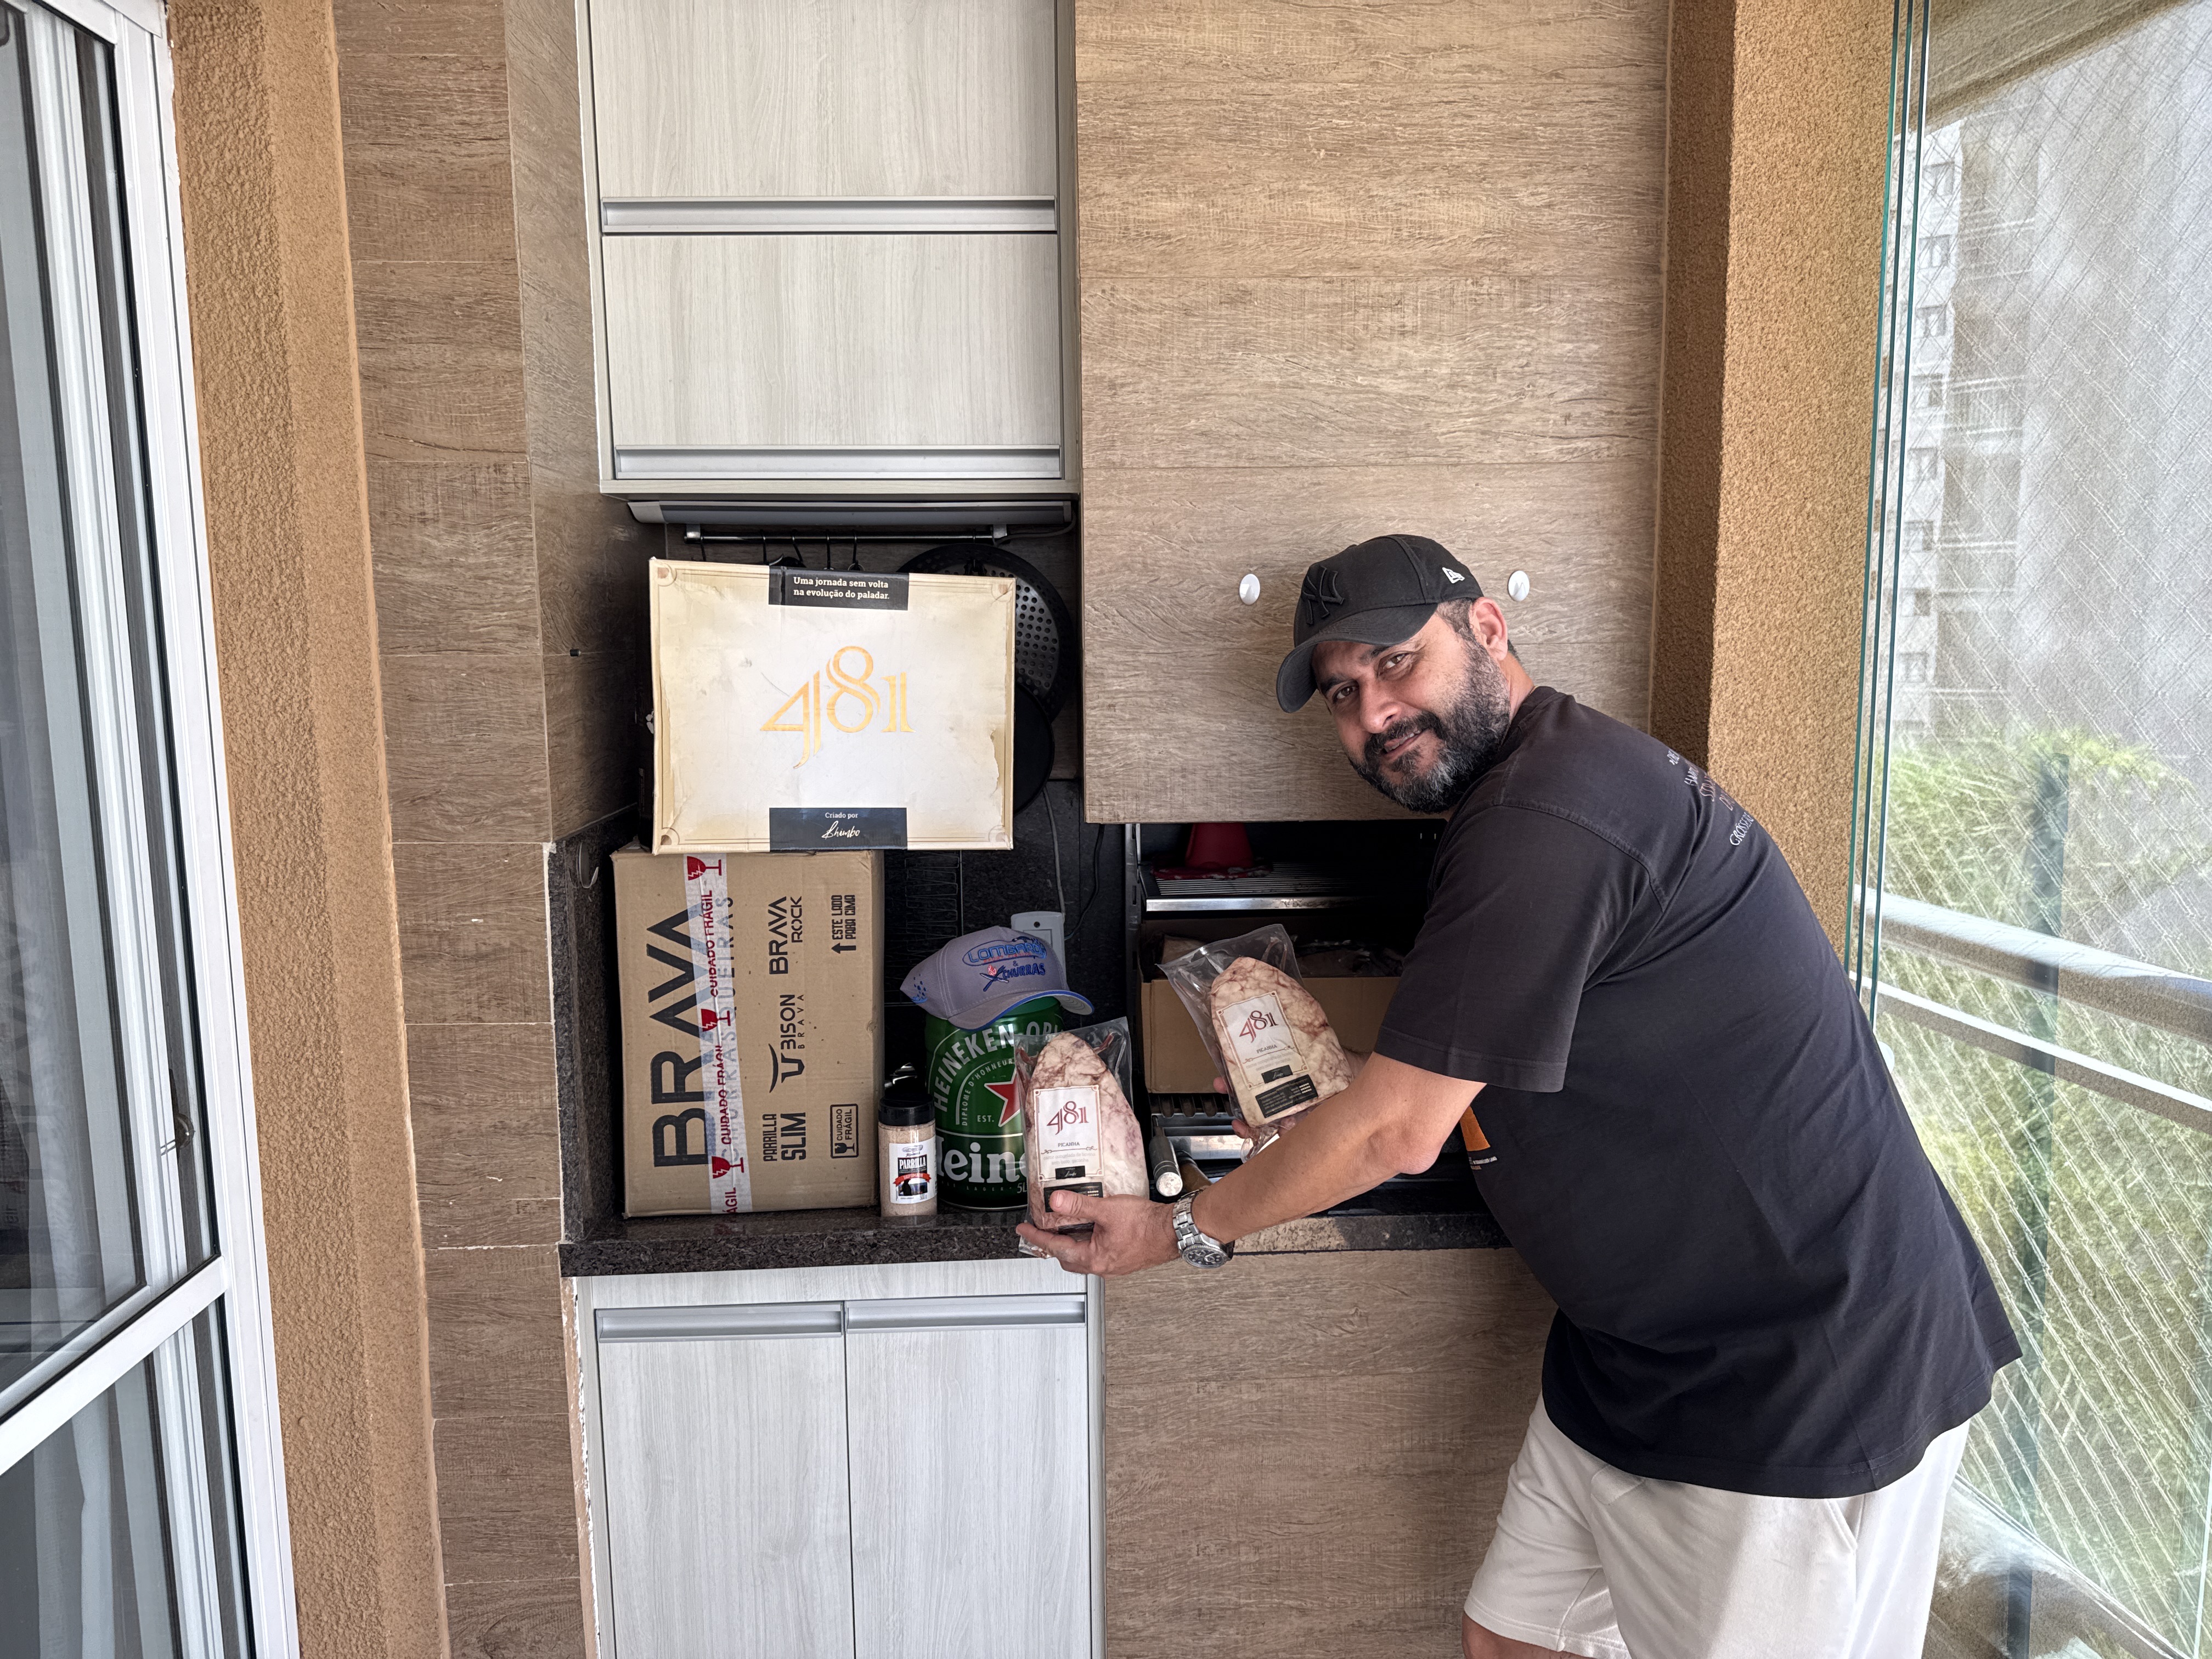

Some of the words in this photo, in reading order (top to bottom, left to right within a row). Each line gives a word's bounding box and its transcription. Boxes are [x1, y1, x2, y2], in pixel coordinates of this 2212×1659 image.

[793, 577, 814, 585] Uma
[815, 577, 847, 586] jornada
[806, 589, 844, 599] evolução
[845, 590, 856, 598] do
[857, 591, 890, 600] paladar.
[759, 645, 916, 769] 481
[699, 890, 714, 936] FRÁGIL
[790, 895, 803, 943] ROCK
[831, 895, 843, 916] LADO
[844, 894, 856, 916] CIMA
[768, 896, 788, 975] BRAVA
[831, 918, 843, 940] ESTE
[844, 918, 856, 940] PARA
[1002, 963, 1046, 979] CHURRAS
[646, 900, 715, 1167] BRAVA
[780, 994, 796, 1050] BISON
[797, 994, 805, 1049] BRAVA
[1239, 1010, 1279, 1043] 481
[934, 1023, 1014, 1113] HEINEKEN
[962, 1089, 971, 1126] DIPLOME
[968, 1058, 1015, 1087] D'HONNEUR
[762, 1113, 777, 1161] PARRILLA
[780, 1112, 806, 1160] SLIM
[844, 1109, 852, 1140] FRÁGIL
[1046, 1101, 1089, 1135] 481
[899, 1156, 927, 1170] PARRILLA
